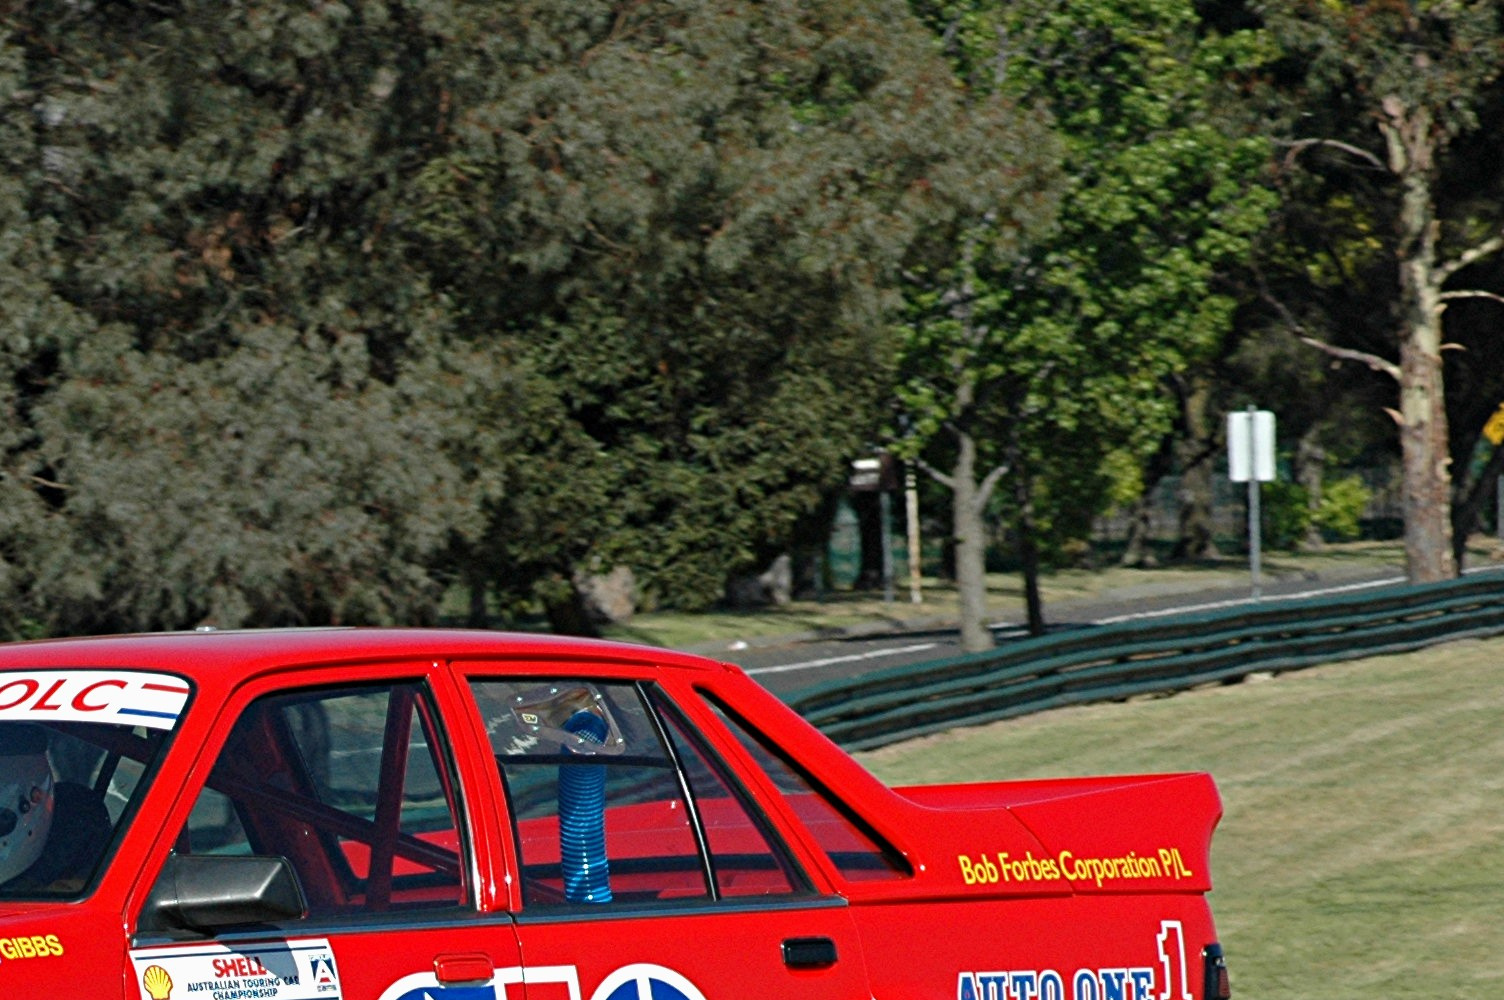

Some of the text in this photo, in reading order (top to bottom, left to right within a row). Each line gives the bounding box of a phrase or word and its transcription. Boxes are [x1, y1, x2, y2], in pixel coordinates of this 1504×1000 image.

[958, 852, 998, 885] Bob
[998, 850, 1060, 882] Forbes
[1058, 850, 1163, 887] Corporation
[212, 956, 268, 978] SHELL
[187, 975, 300, 993] AUSTRALIAN TOURING CAR
[212, 988, 279, 1000] CHAMPIONSHIP
